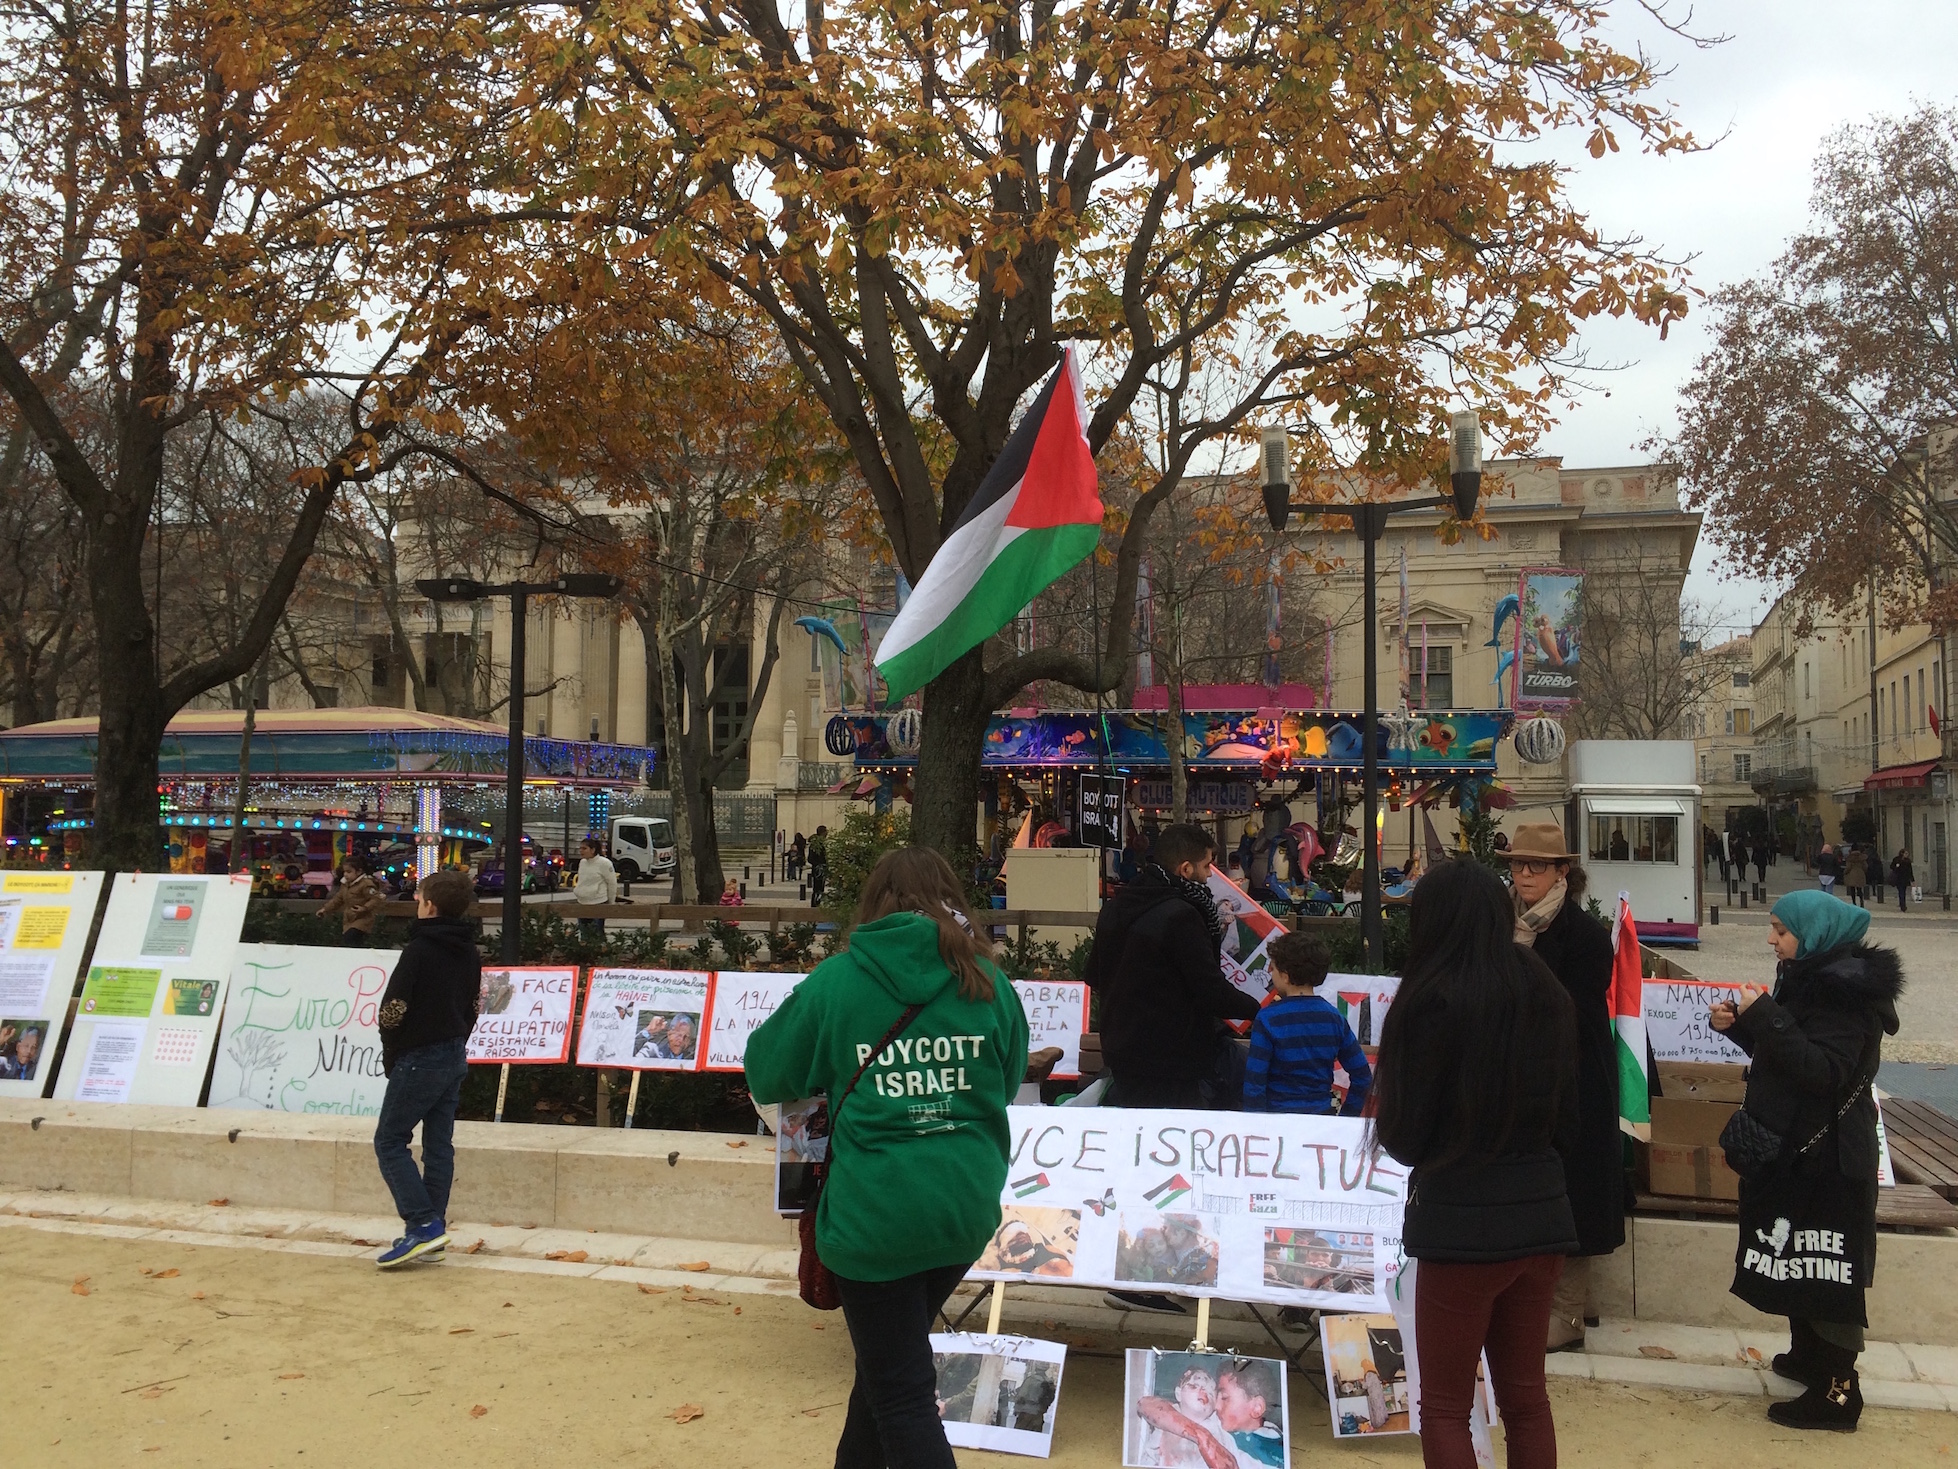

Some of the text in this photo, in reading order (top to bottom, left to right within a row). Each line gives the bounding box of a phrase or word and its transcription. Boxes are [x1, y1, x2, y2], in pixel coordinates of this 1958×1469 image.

[1525, 675, 1578, 688] TURBO
[1083, 791, 1119, 809] BOYOTT
[1140, 785, 1247, 806] CLUB AUTIQUE
[1083, 811, 1109, 827] ISRAL
[173, 981, 200, 989] Vitale
[522, 979, 571, 994] FACE
[528, 999, 544, 1017] A
[1031, 1005, 1059, 1019] ET
[714, 1017, 736, 1031] LA
[855, 1035, 985, 1068] BOYCOTT
[874, 1067, 972, 1098] ISRAEL
[1249, 1193, 1277, 1203] FREE
[1793, 1229, 1845, 1255] FREE
